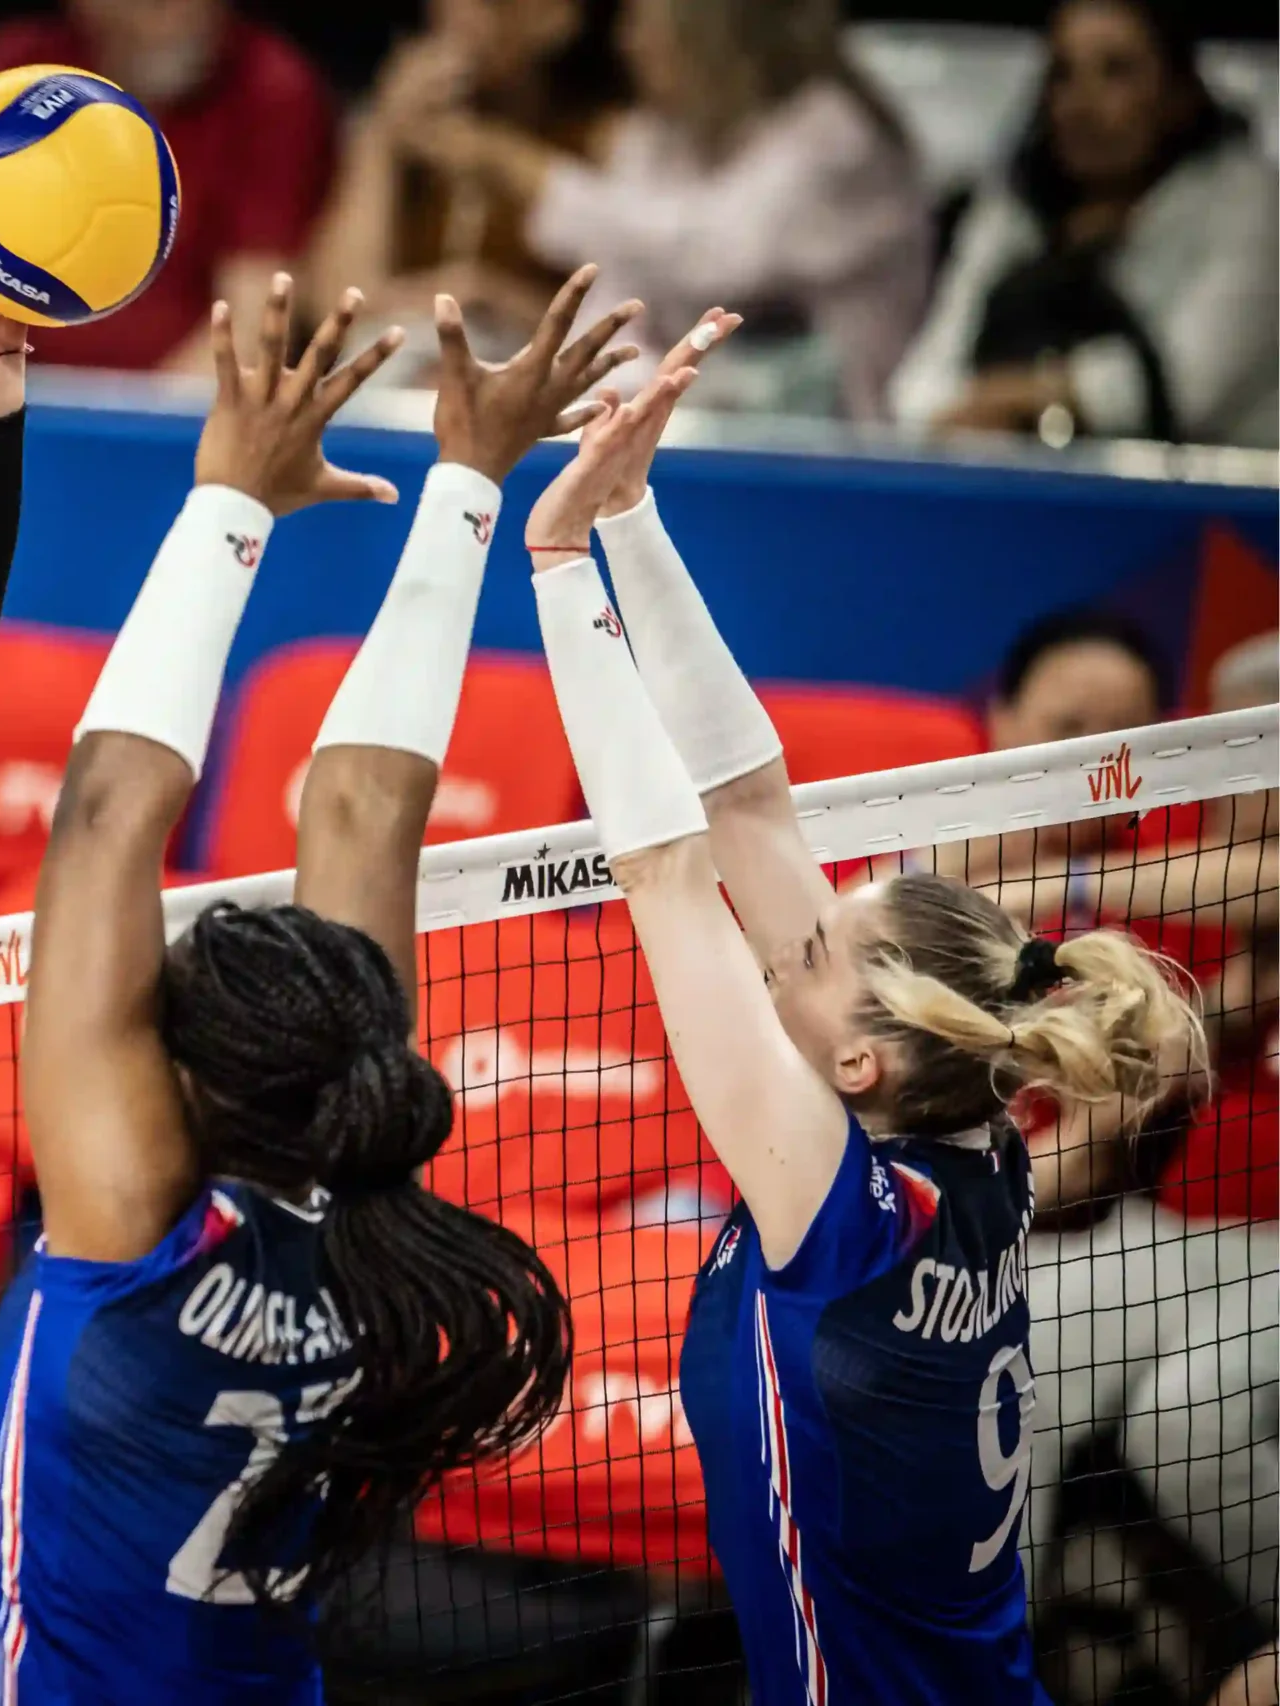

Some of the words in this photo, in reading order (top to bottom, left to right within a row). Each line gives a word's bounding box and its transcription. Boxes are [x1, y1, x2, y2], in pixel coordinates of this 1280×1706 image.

[1087, 742, 1143, 802] VNL
[500, 848, 618, 903] MIKAS
[967, 1344, 1037, 1574] 9
